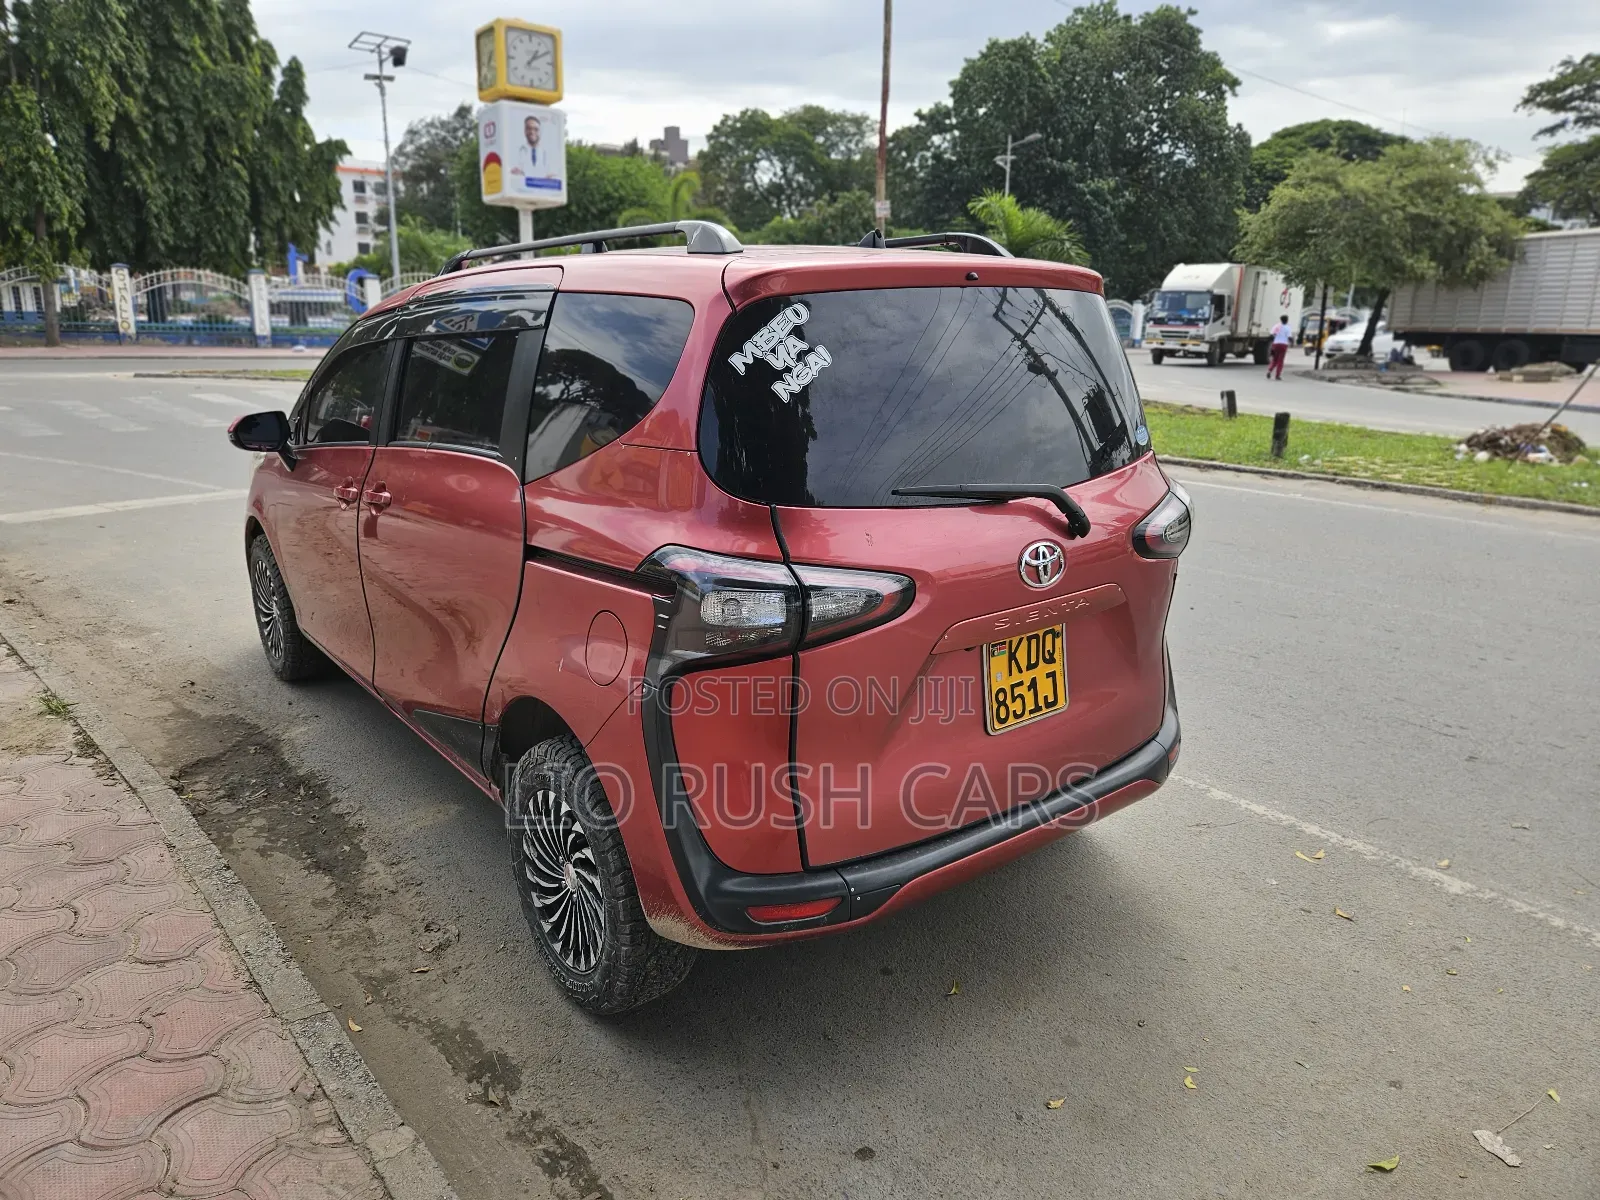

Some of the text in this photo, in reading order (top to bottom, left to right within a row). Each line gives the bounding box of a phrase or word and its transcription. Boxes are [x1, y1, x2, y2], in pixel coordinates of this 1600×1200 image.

[764, 335, 809, 370] YA
[771, 345, 832, 403] NGAI
[994, 598, 1090, 631] SIENTA
[1007, 627, 1058, 677] KDQ
[994, 670, 1059, 725] 851J
